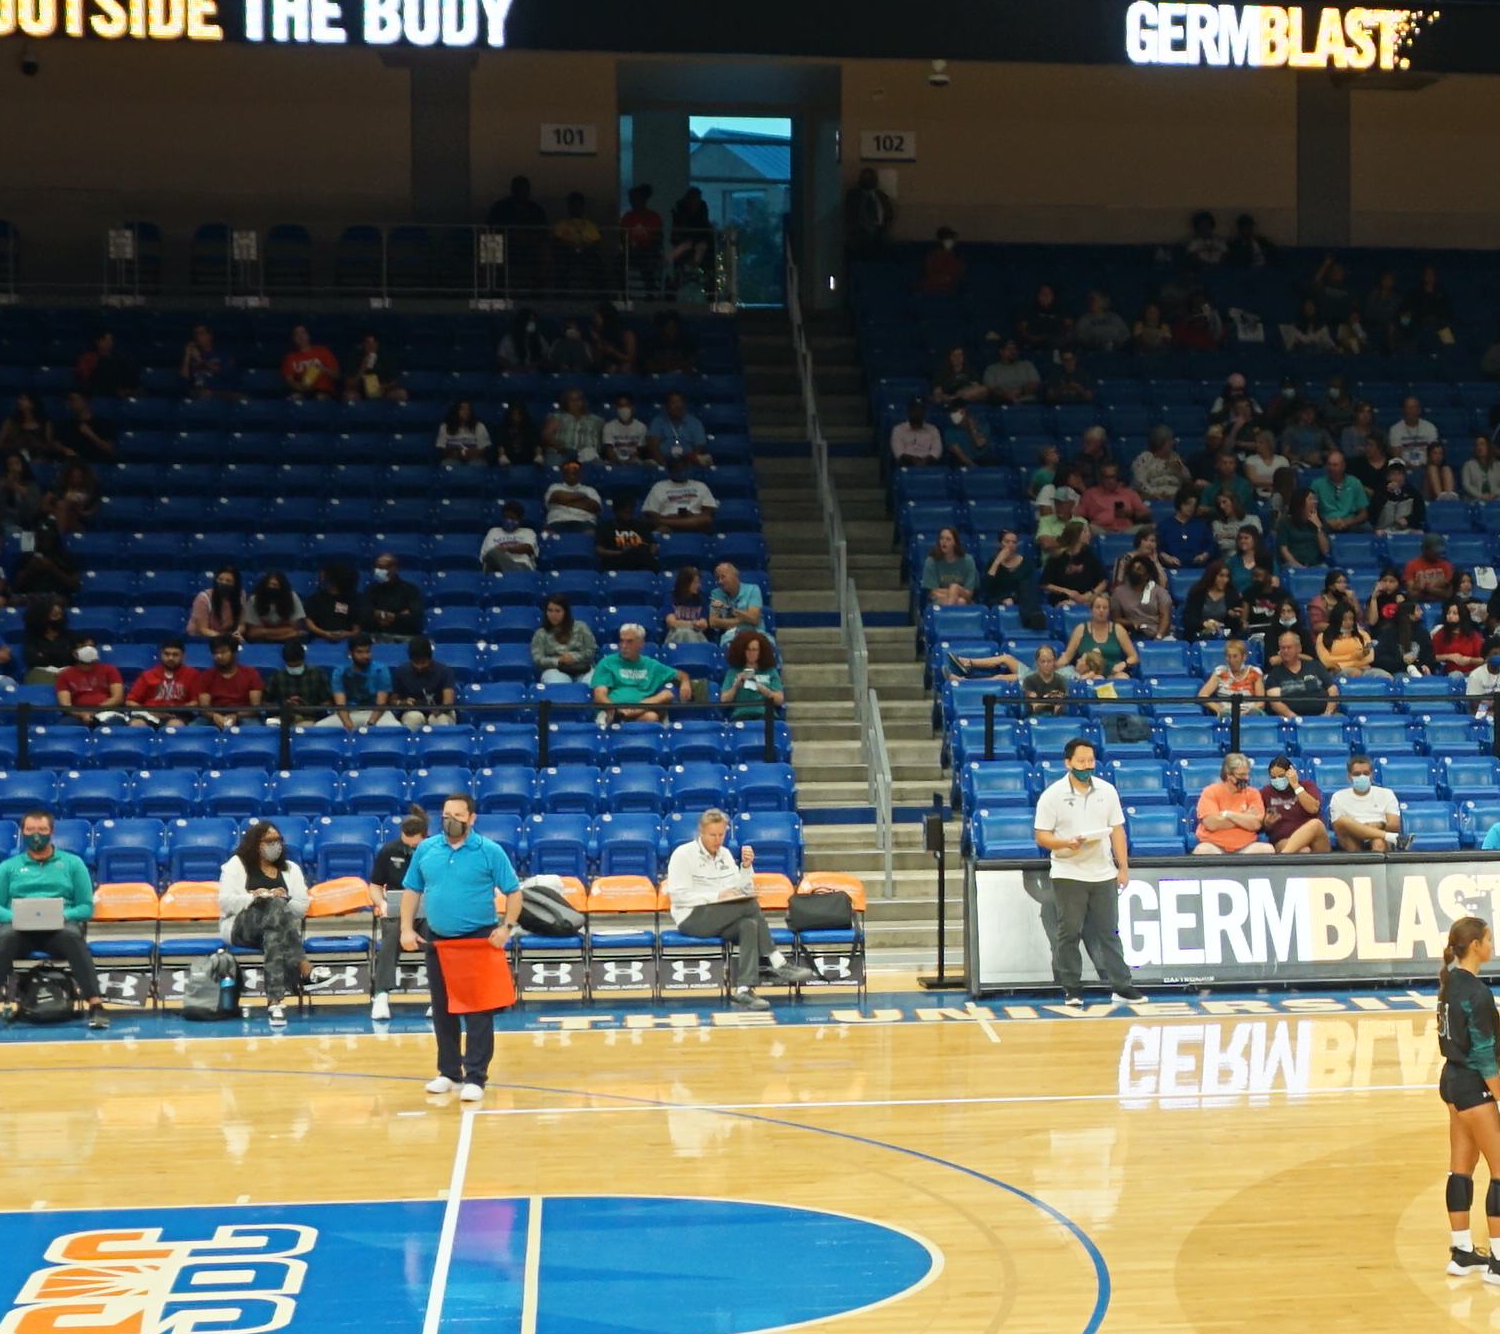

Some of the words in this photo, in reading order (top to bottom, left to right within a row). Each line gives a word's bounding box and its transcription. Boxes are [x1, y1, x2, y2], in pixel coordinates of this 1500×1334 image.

[1126, 0, 1410, 69] GERMBLAST
[554, 128, 584, 145] 101
[873, 135, 904, 152] 102
[538, 1010, 778, 1029] THE
